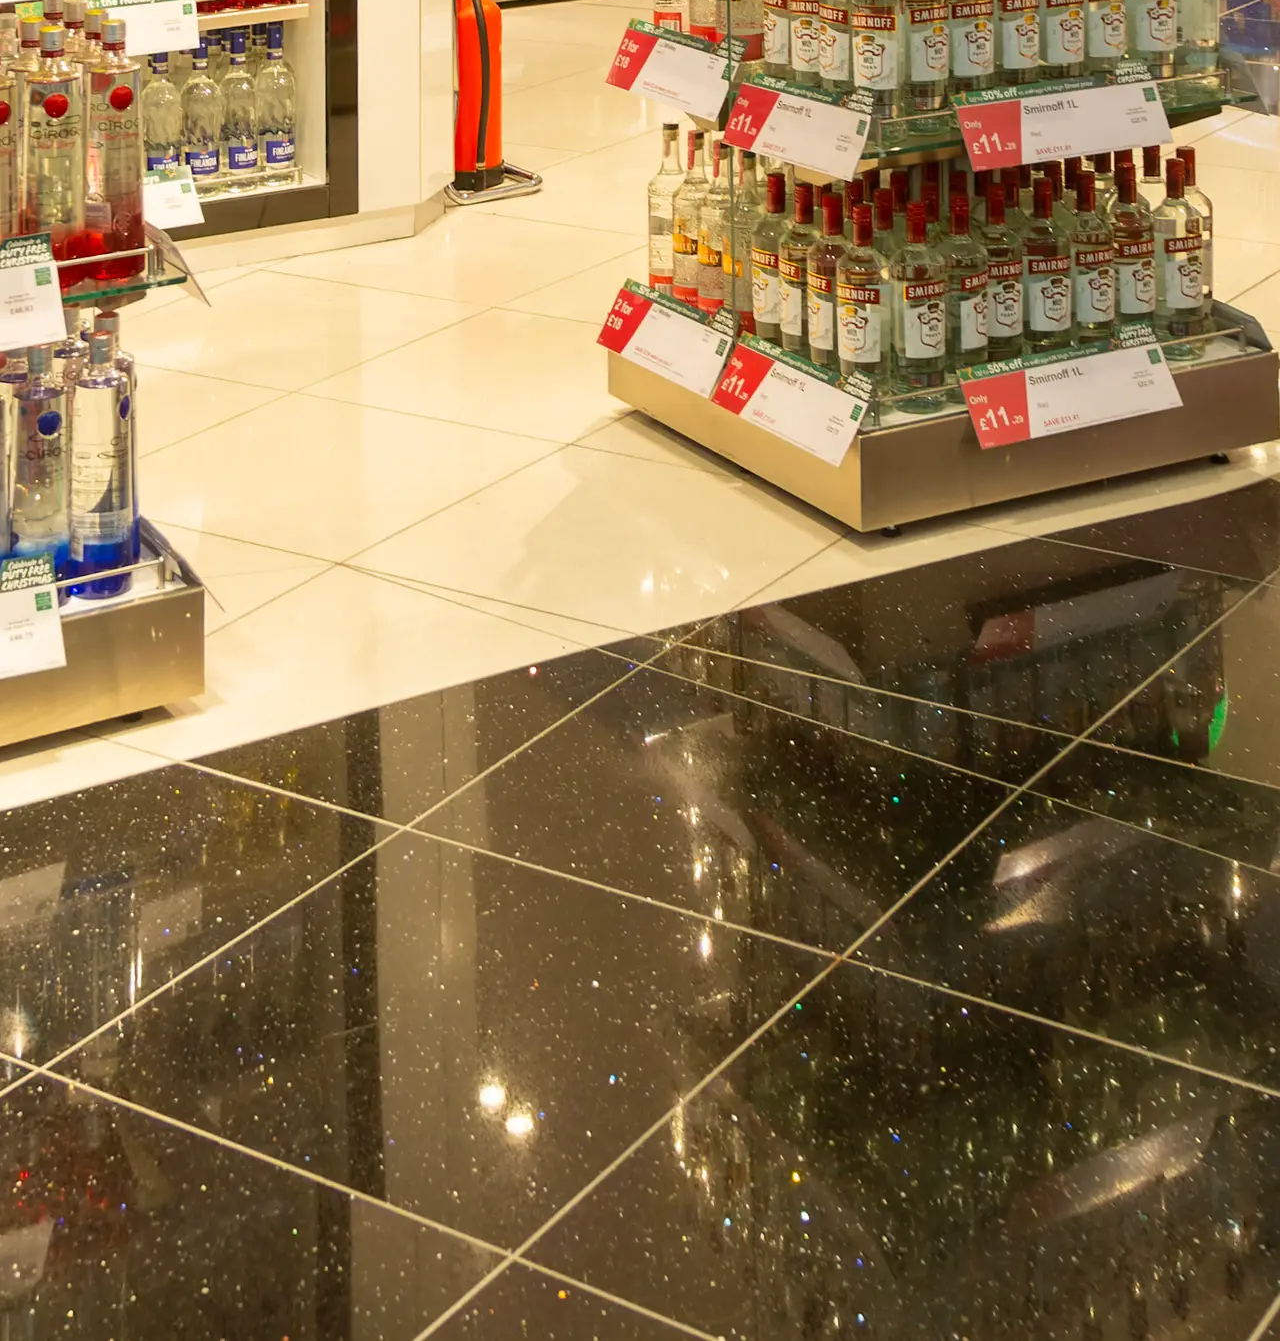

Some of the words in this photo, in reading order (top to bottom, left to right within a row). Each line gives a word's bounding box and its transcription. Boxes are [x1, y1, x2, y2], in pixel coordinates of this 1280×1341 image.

[981, 89, 1003, 101] 50%
[1004, 87, 1018, 98] off
[1023, 101, 1065, 115] Smirnoff
[1067, 100, 1079, 110] 1L
[964, 120, 982, 130] Only
[987, 363, 1009, 375] 50%
[1010, 360, 1023, 370] off
[769, 367, 798, 388] Smirnoff
[1028, 370, 1070, 386] Smirnoff
[1072, 367, 1084, 377] 1L
[969, 395, 988, 405] Only
